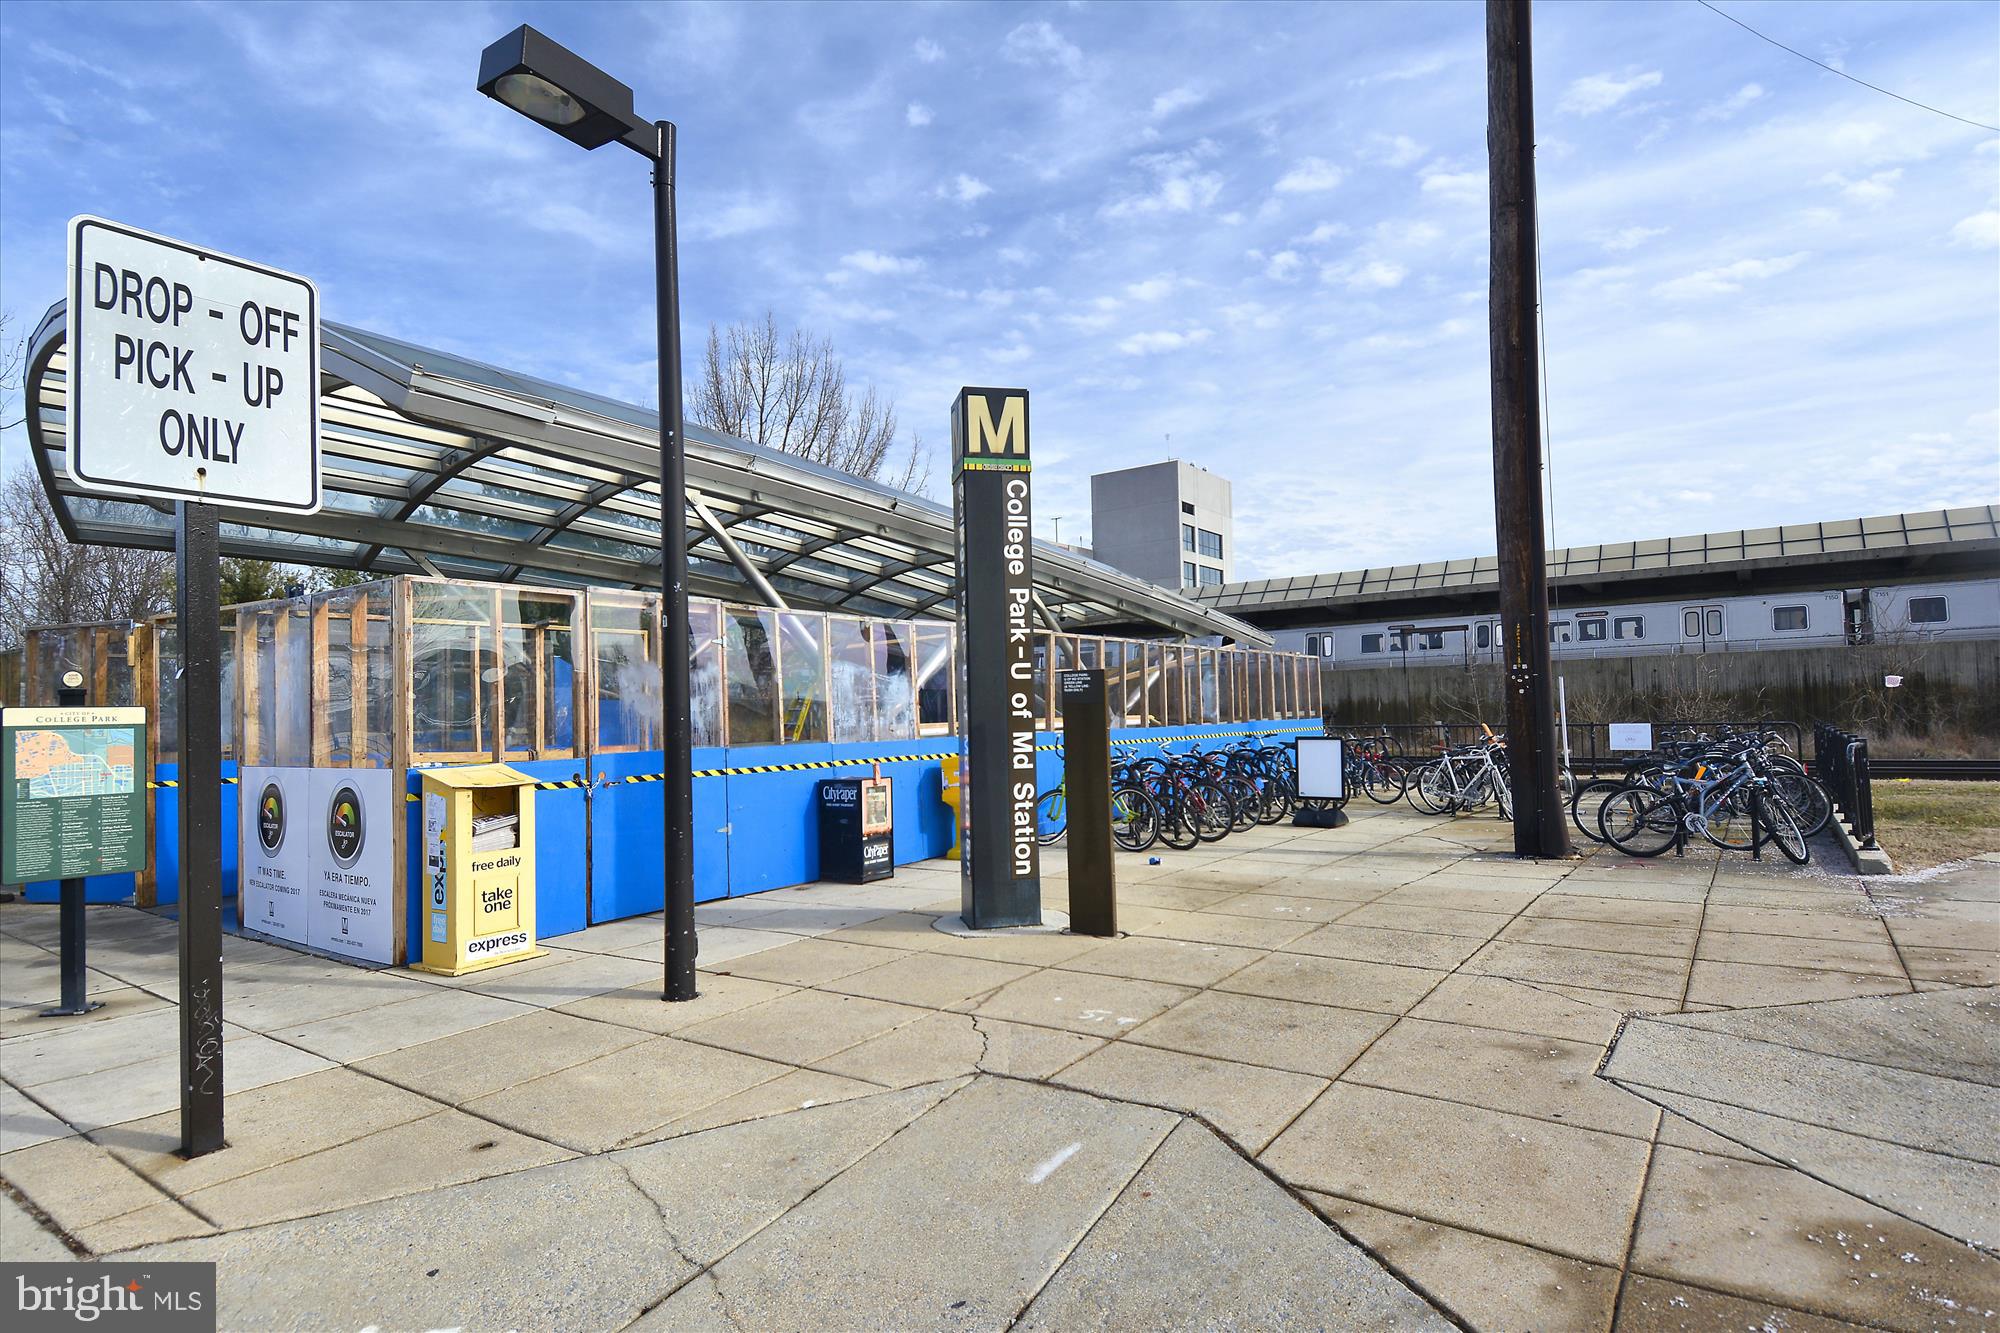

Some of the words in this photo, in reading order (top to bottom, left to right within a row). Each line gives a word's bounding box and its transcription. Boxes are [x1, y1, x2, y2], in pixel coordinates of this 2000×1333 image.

[94, 262, 193, 327] DROP
[239, 300, 300, 352] OFF
[114, 333, 196, 394] PICK
[243, 362, 284, 409] UP
[967, 394, 1026, 454] M
[159, 408, 245, 464] ONLY
[1003, 479, 1028, 576] College
[1010, 692, 1033, 719] of
[1012, 731, 1034, 769] Md
[335, 830, 354, 838] ESCALATOR
[1013, 782, 1036, 876] Station
[472, 861, 494, 872] free
[496, 855, 521, 868] daily
[323, 870, 331, 881] YA
[331, 872, 343, 883] ERA
[344, 874, 371, 887] TIEMPO.
[290, 887, 301, 896] 2017
[319, 889, 338, 899] ESCALERA
[360, 897, 377, 906] NUEVA
[481, 886, 513, 903] take
[353, 906, 360, 914] EN
[360, 908, 371, 916] 2017
[484, 899, 511, 913] one
[468, 932, 527, 953] express
